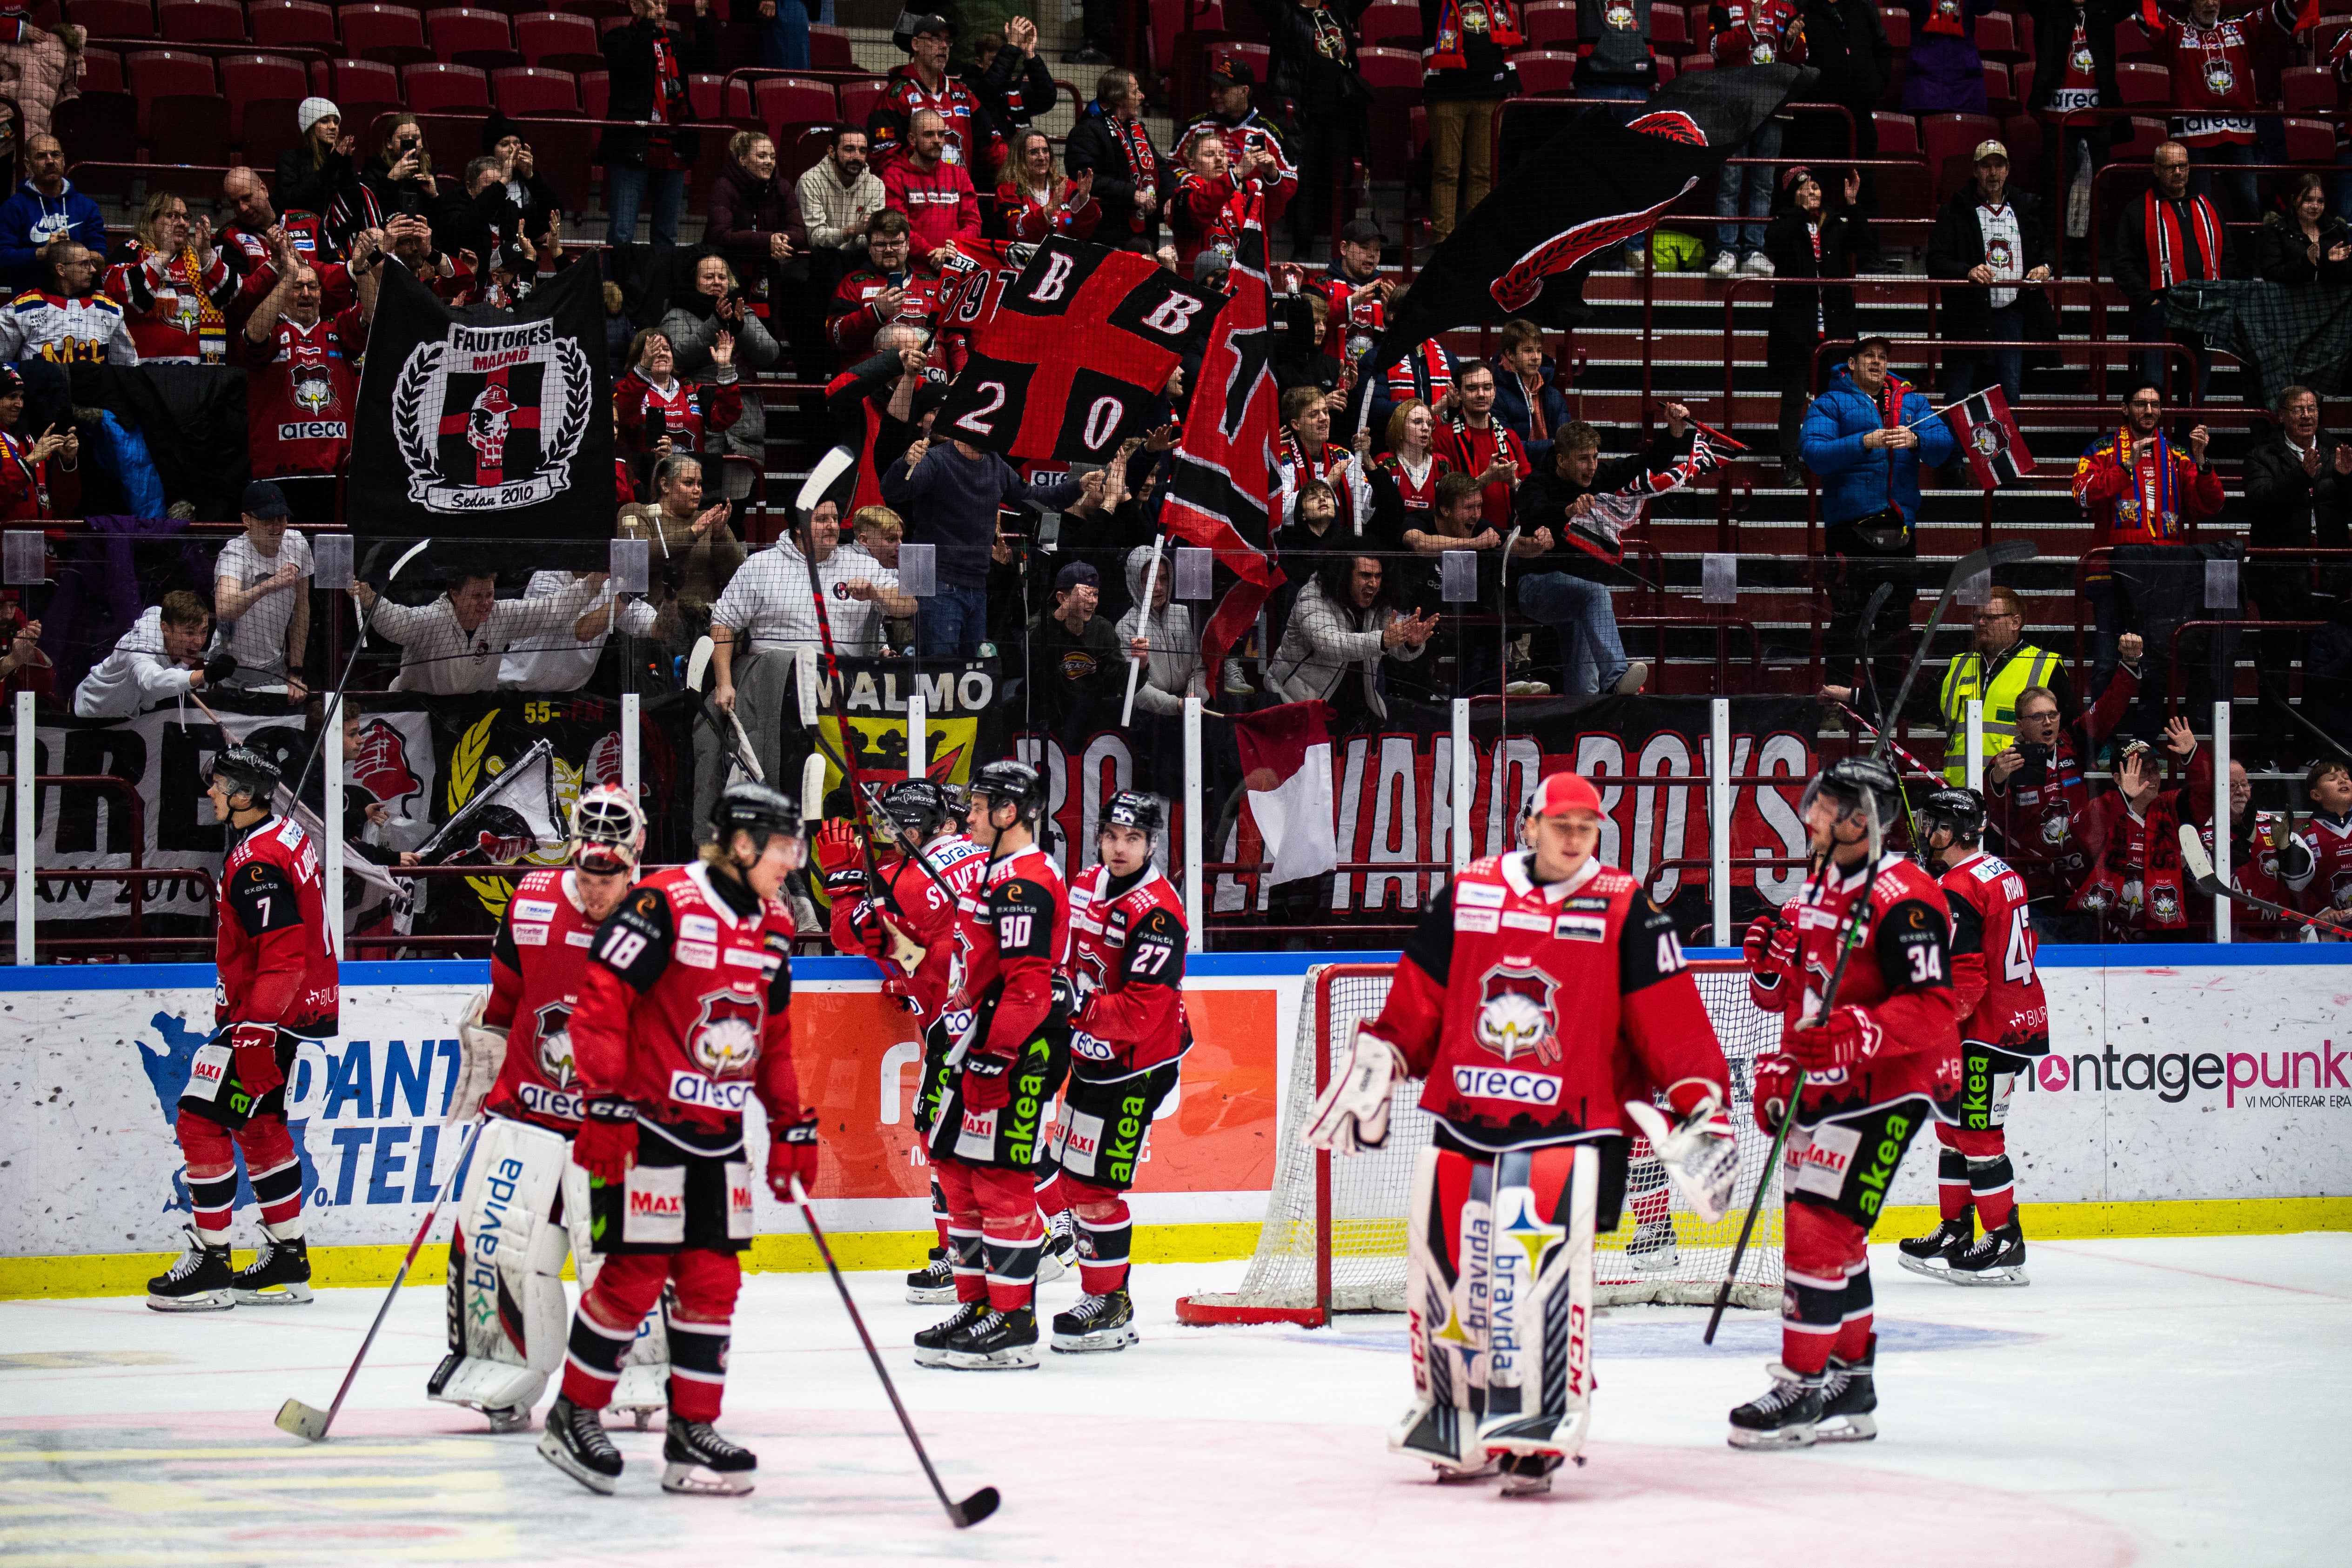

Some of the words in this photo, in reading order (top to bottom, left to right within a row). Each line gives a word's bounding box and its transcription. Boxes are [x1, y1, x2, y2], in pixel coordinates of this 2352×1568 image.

[2186, 117, 2251, 131] areco
[1027, 250, 1075, 302] B
[1140, 288, 1204, 335] B
[453, 324, 552, 353] FAUTORES
[473, 347, 529, 371] MALMÖ
[954, 381, 1006, 436] 2
[451, 492, 497, 509] Sedan
[501, 486, 534, 505] 2010
[814, 662, 993, 711] MALMÖ
[2058, 758, 2076, 768] RSA
[909, 793, 937, 805] kjellander
[1004, 784, 1025, 792] CCM
[244, 883, 278, 895] exakta
[257, 896, 271, 928] 7
[996, 905, 1038, 914] exakta
[599, 925, 647, 970] 18
[1000, 915, 1032, 948] 90
[1138, 931, 1174, 946] exakta
[1130, 943, 1171, 975] 27
[1907, 944, 1942, 982] 34
[1456, 1068, 1557, 1104] areco
[2014, 1039, 2352, 1108] montagepunk
[1963, 1055, 1989, 1130] akea
[2245, 1096, 2257, 1108] VI
[2260, 1096, 2326, 1108] MONTERAR
[2329, 1095, 2352, 1108] ERA
[1004, 1074, 1044, 1165] akea
[1105, 1096, 1146, 1183] akea
[1859, 1114, 1909, 1215] akea
[467, 1157, 524, 1293] bravida
[1463, 1217, 1490, 1332] bravida
[447, 1261, 459, 1344] CCM
[1493, 1254, 1523, 1373] bravida
[1570, 1303, 1586, 1396] CCM
